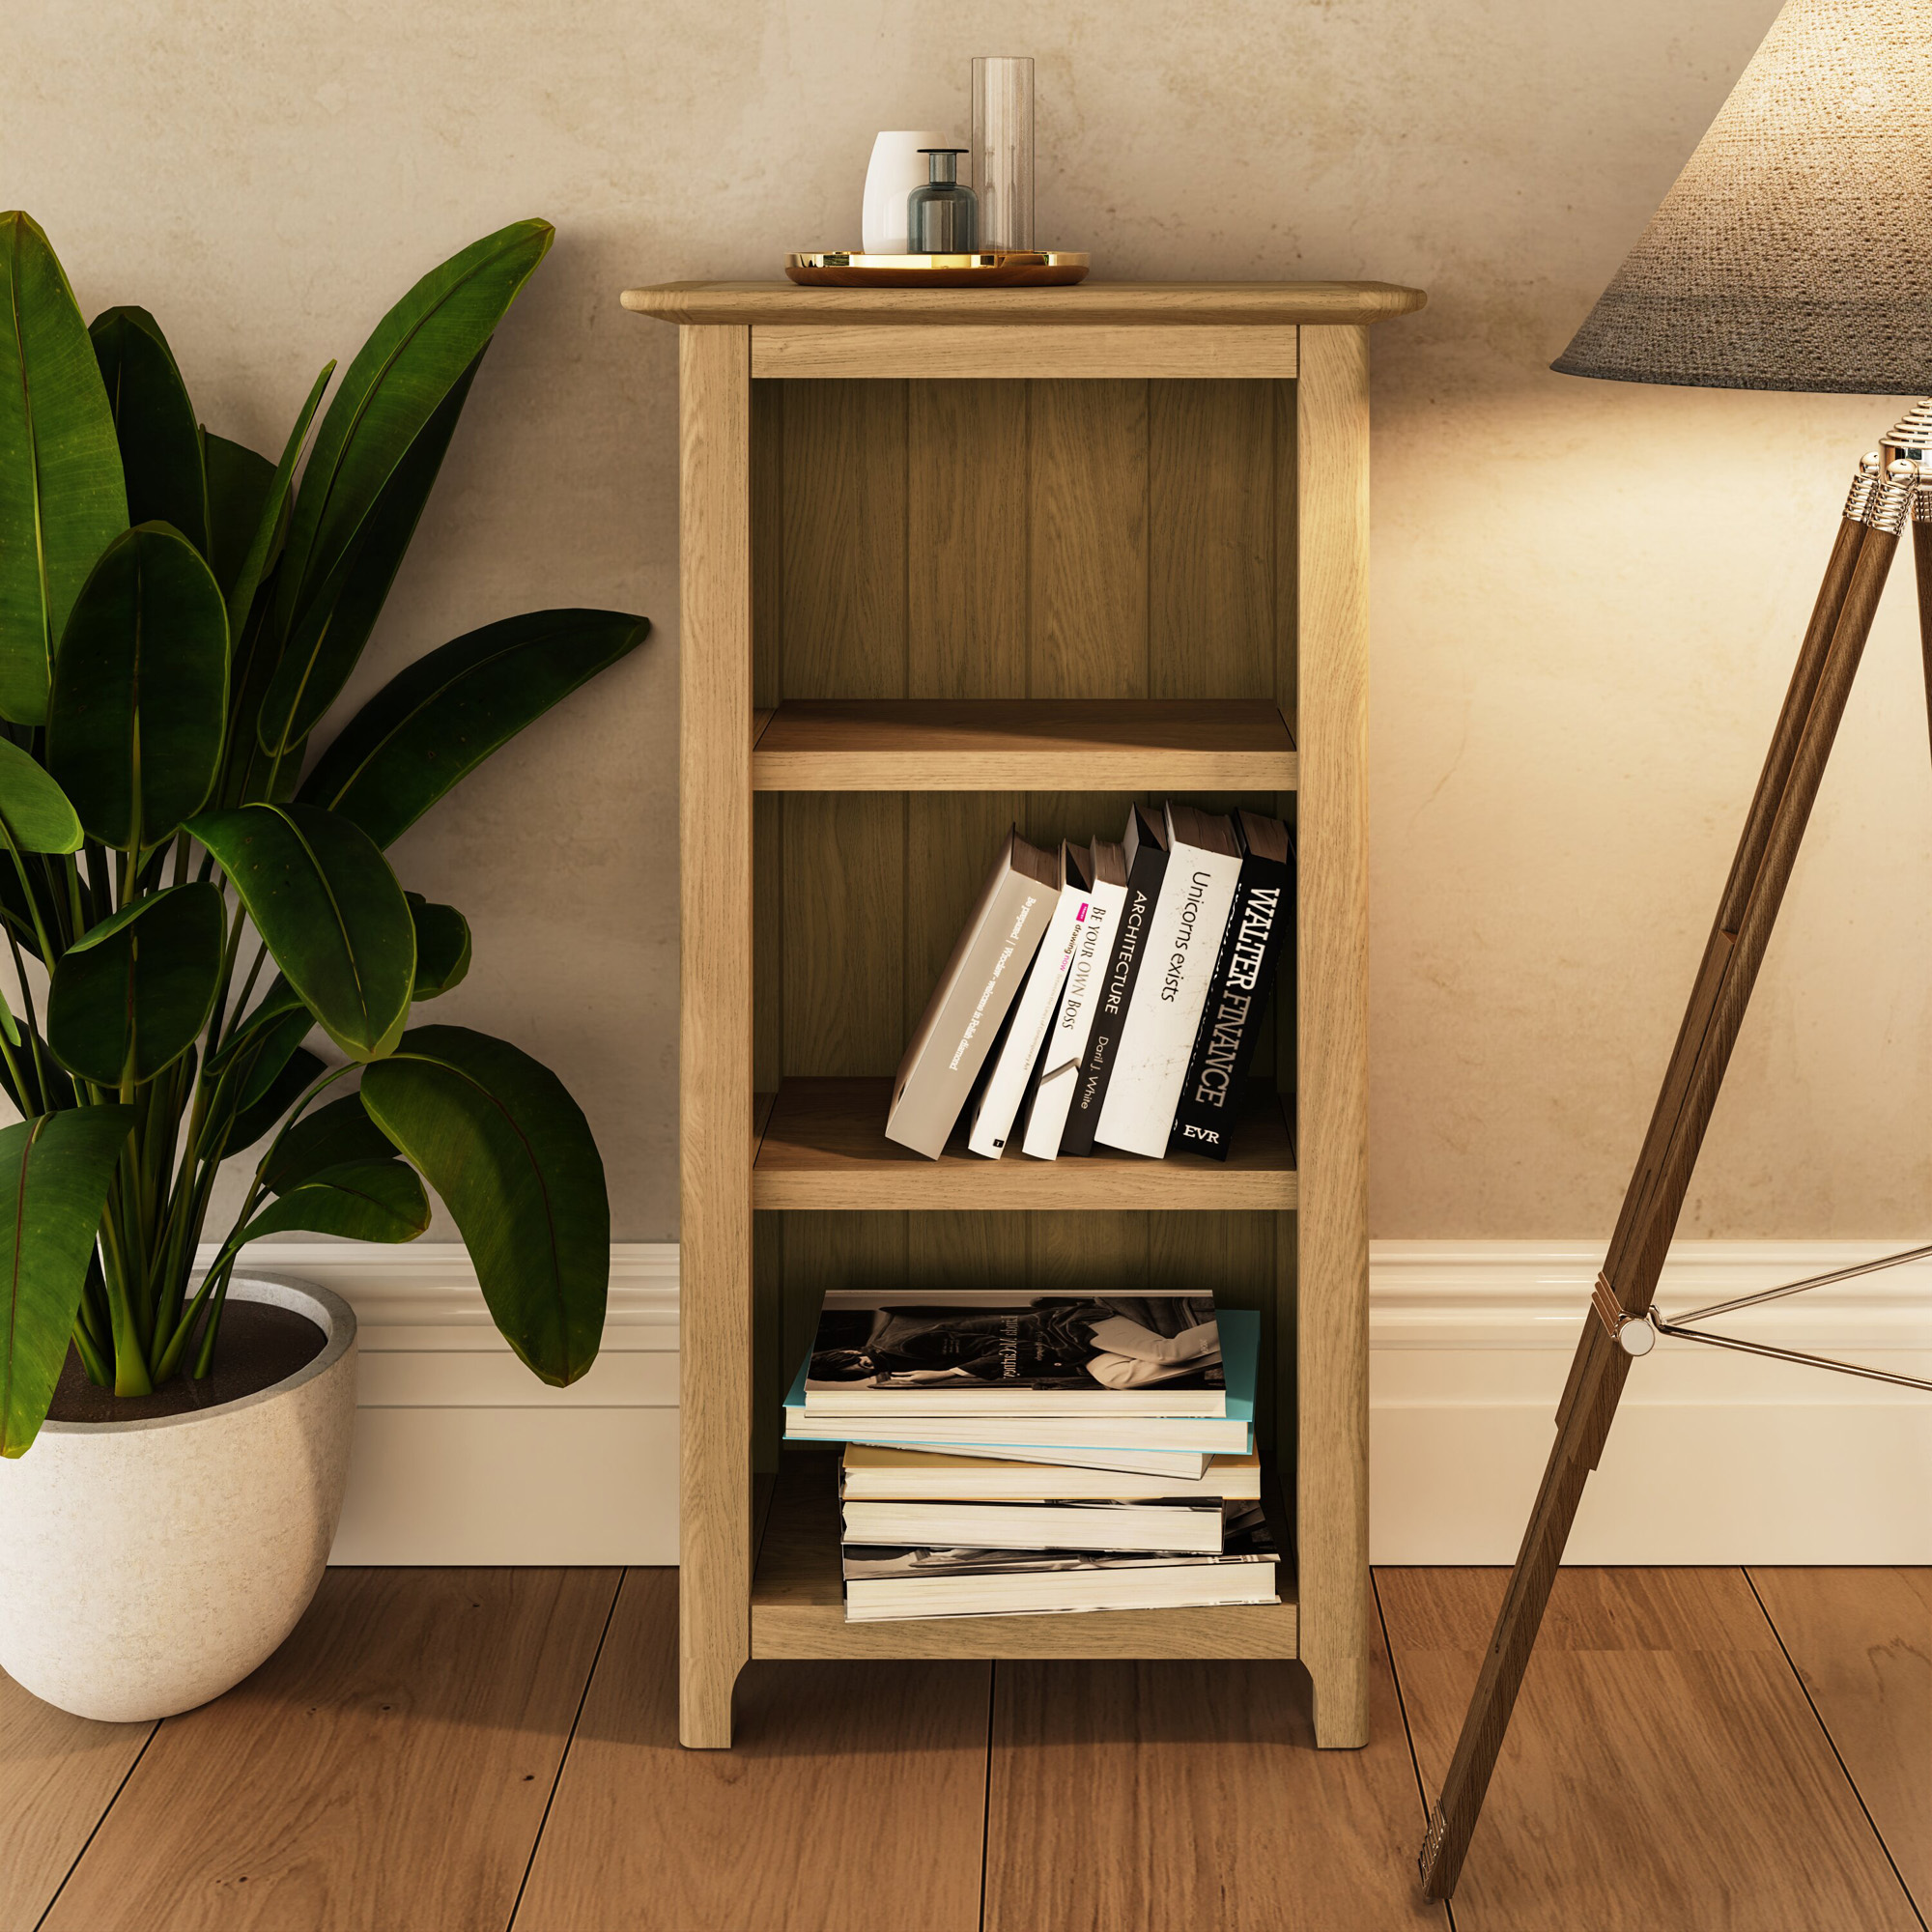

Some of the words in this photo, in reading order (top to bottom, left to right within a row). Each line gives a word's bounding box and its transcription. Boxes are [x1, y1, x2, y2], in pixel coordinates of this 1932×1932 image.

[1025, 895, 1037, 907] Be
[1175, 871, 1211, 950] Unicorns
[1009, 904, 1030, 940] prepared
[1064, 923, 1082, 954] drawing
[1104, 890, 1148, 1014] ARCHITECTURE
[1225, 888, 1280, 990] WALTER
[1059, 954, 1069, 972] now
[1160, 952, 1185, 1003] exists
[1070, 961, 1091, 997] OWN
[976, 980, 996, 1011] welcome
[963, 1017, 980, 1039] Polish
[972, 1010, 983, 1019] in
[949, 1038, 969, 1070] diamond
[1094, 1036, 1109, 1063] Daril
[1195, 989, 1251, 1107] FINANCE
[1090, 1063, 1100, 1071] J.
[1080, 1076, 1098, 1109] White
[1182, 1123, 1219, 1144] EVR
